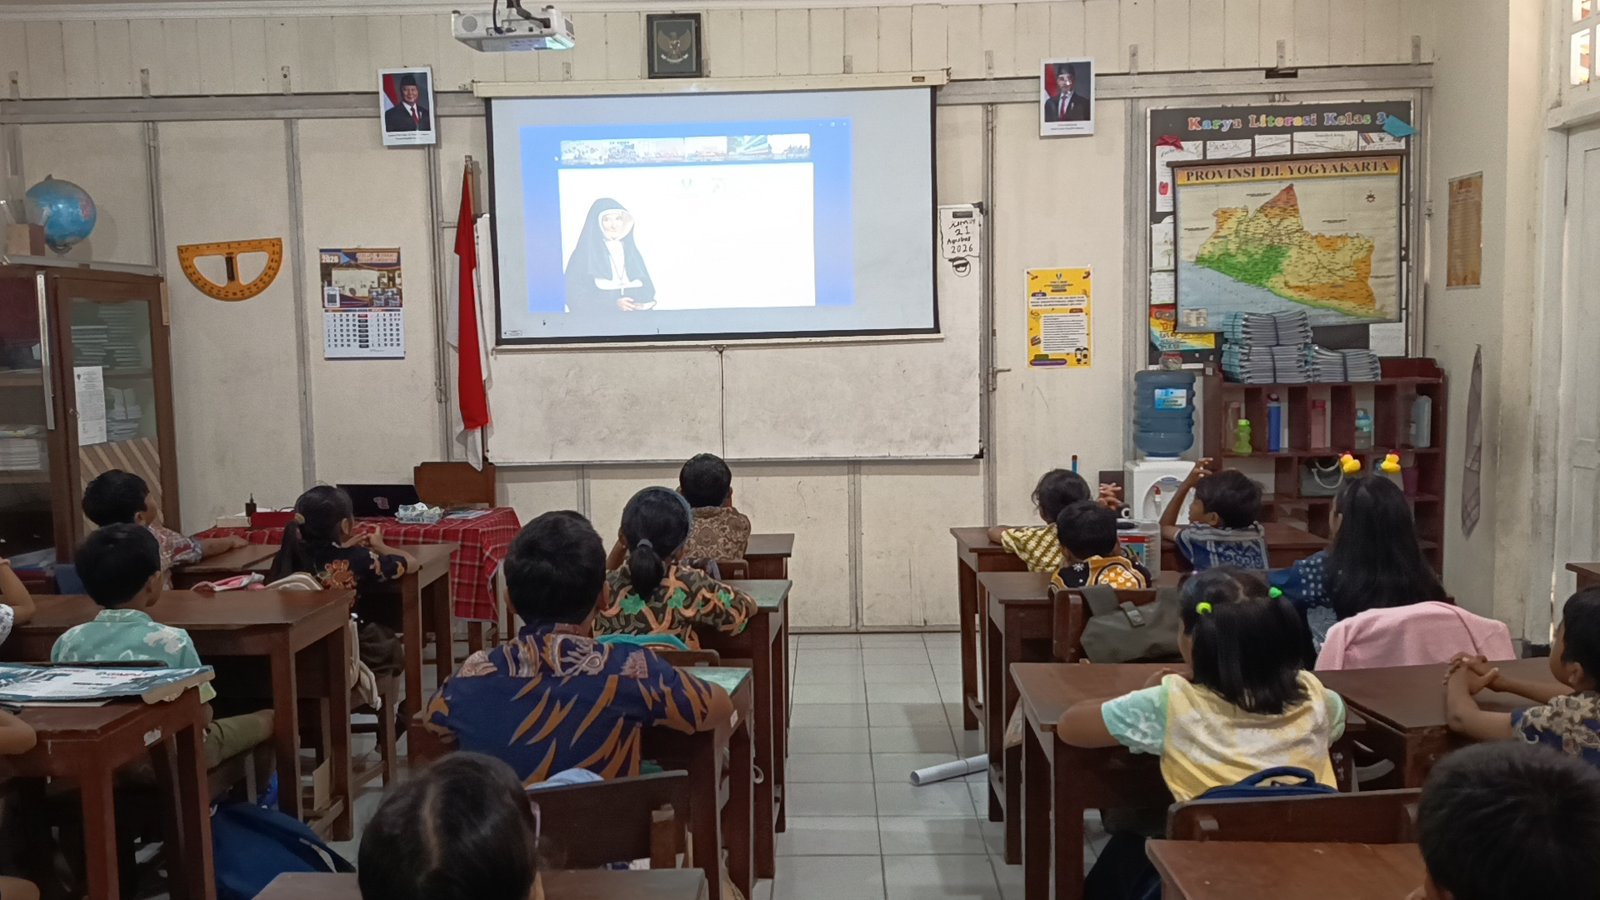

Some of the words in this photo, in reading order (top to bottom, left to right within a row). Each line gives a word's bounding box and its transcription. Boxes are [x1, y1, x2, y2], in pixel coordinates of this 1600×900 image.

[1187, 116, 1242, 132] Karya
[1248, 112, 1317, 128] Literasi
[1323, 111, 1372, 126] Kelas
[1186, 166, 1256, 181] PROVINSI
[1260, 165, 1284, 177] D.I.
[1287, 160, 1389, 175] YOGYAKARTA
[951, 243, 973, 253] 2026
